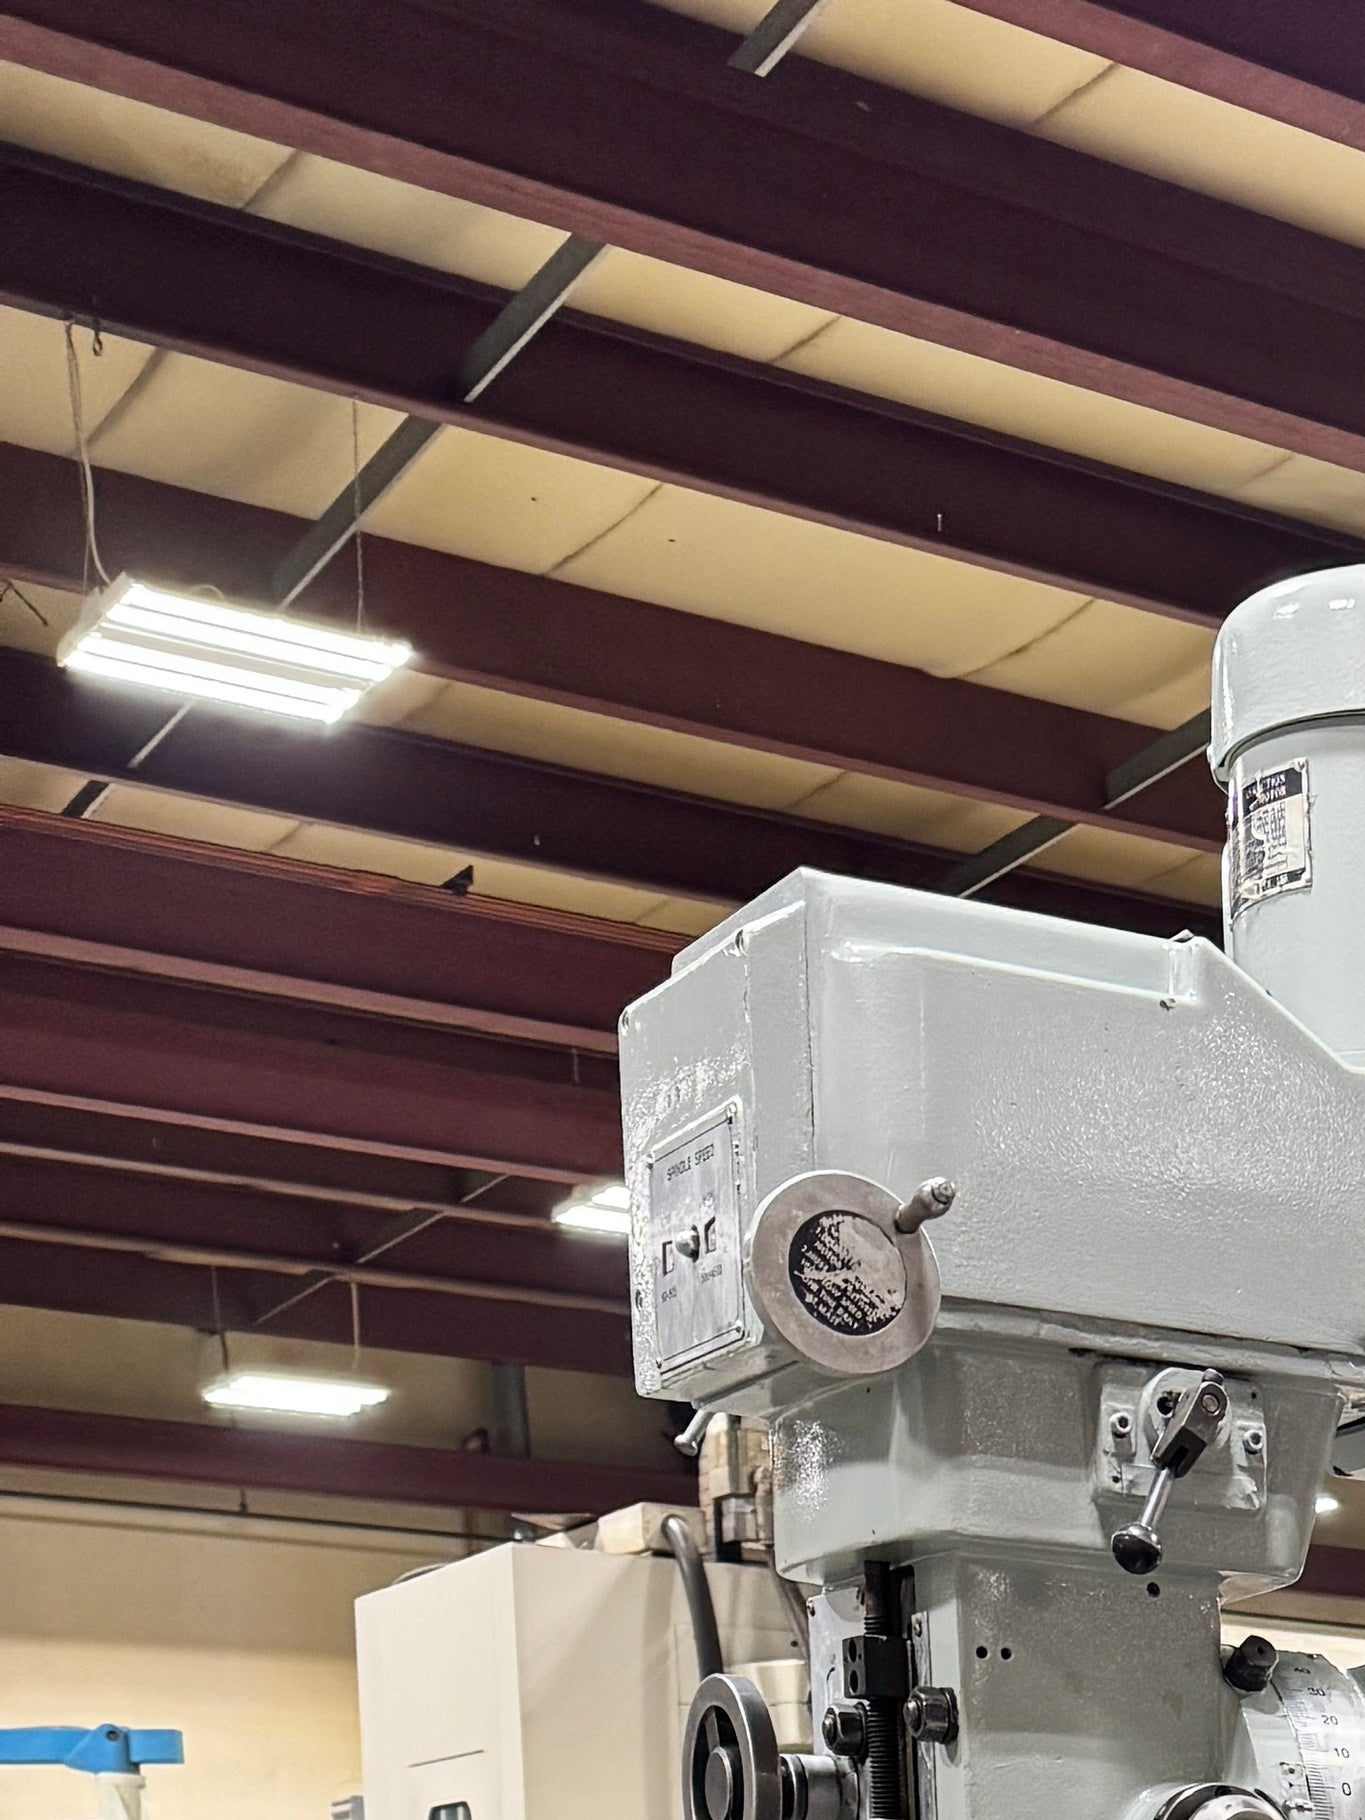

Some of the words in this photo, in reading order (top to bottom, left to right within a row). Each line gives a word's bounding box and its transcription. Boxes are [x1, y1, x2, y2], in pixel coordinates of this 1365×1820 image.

[1308, 1686, 1326, 1697] 30
[1320, 1715, 1339, 1726] 20
[1334, 1748, 1350, 1759] 10
[1342, 1782, 1352, 1797] 0
